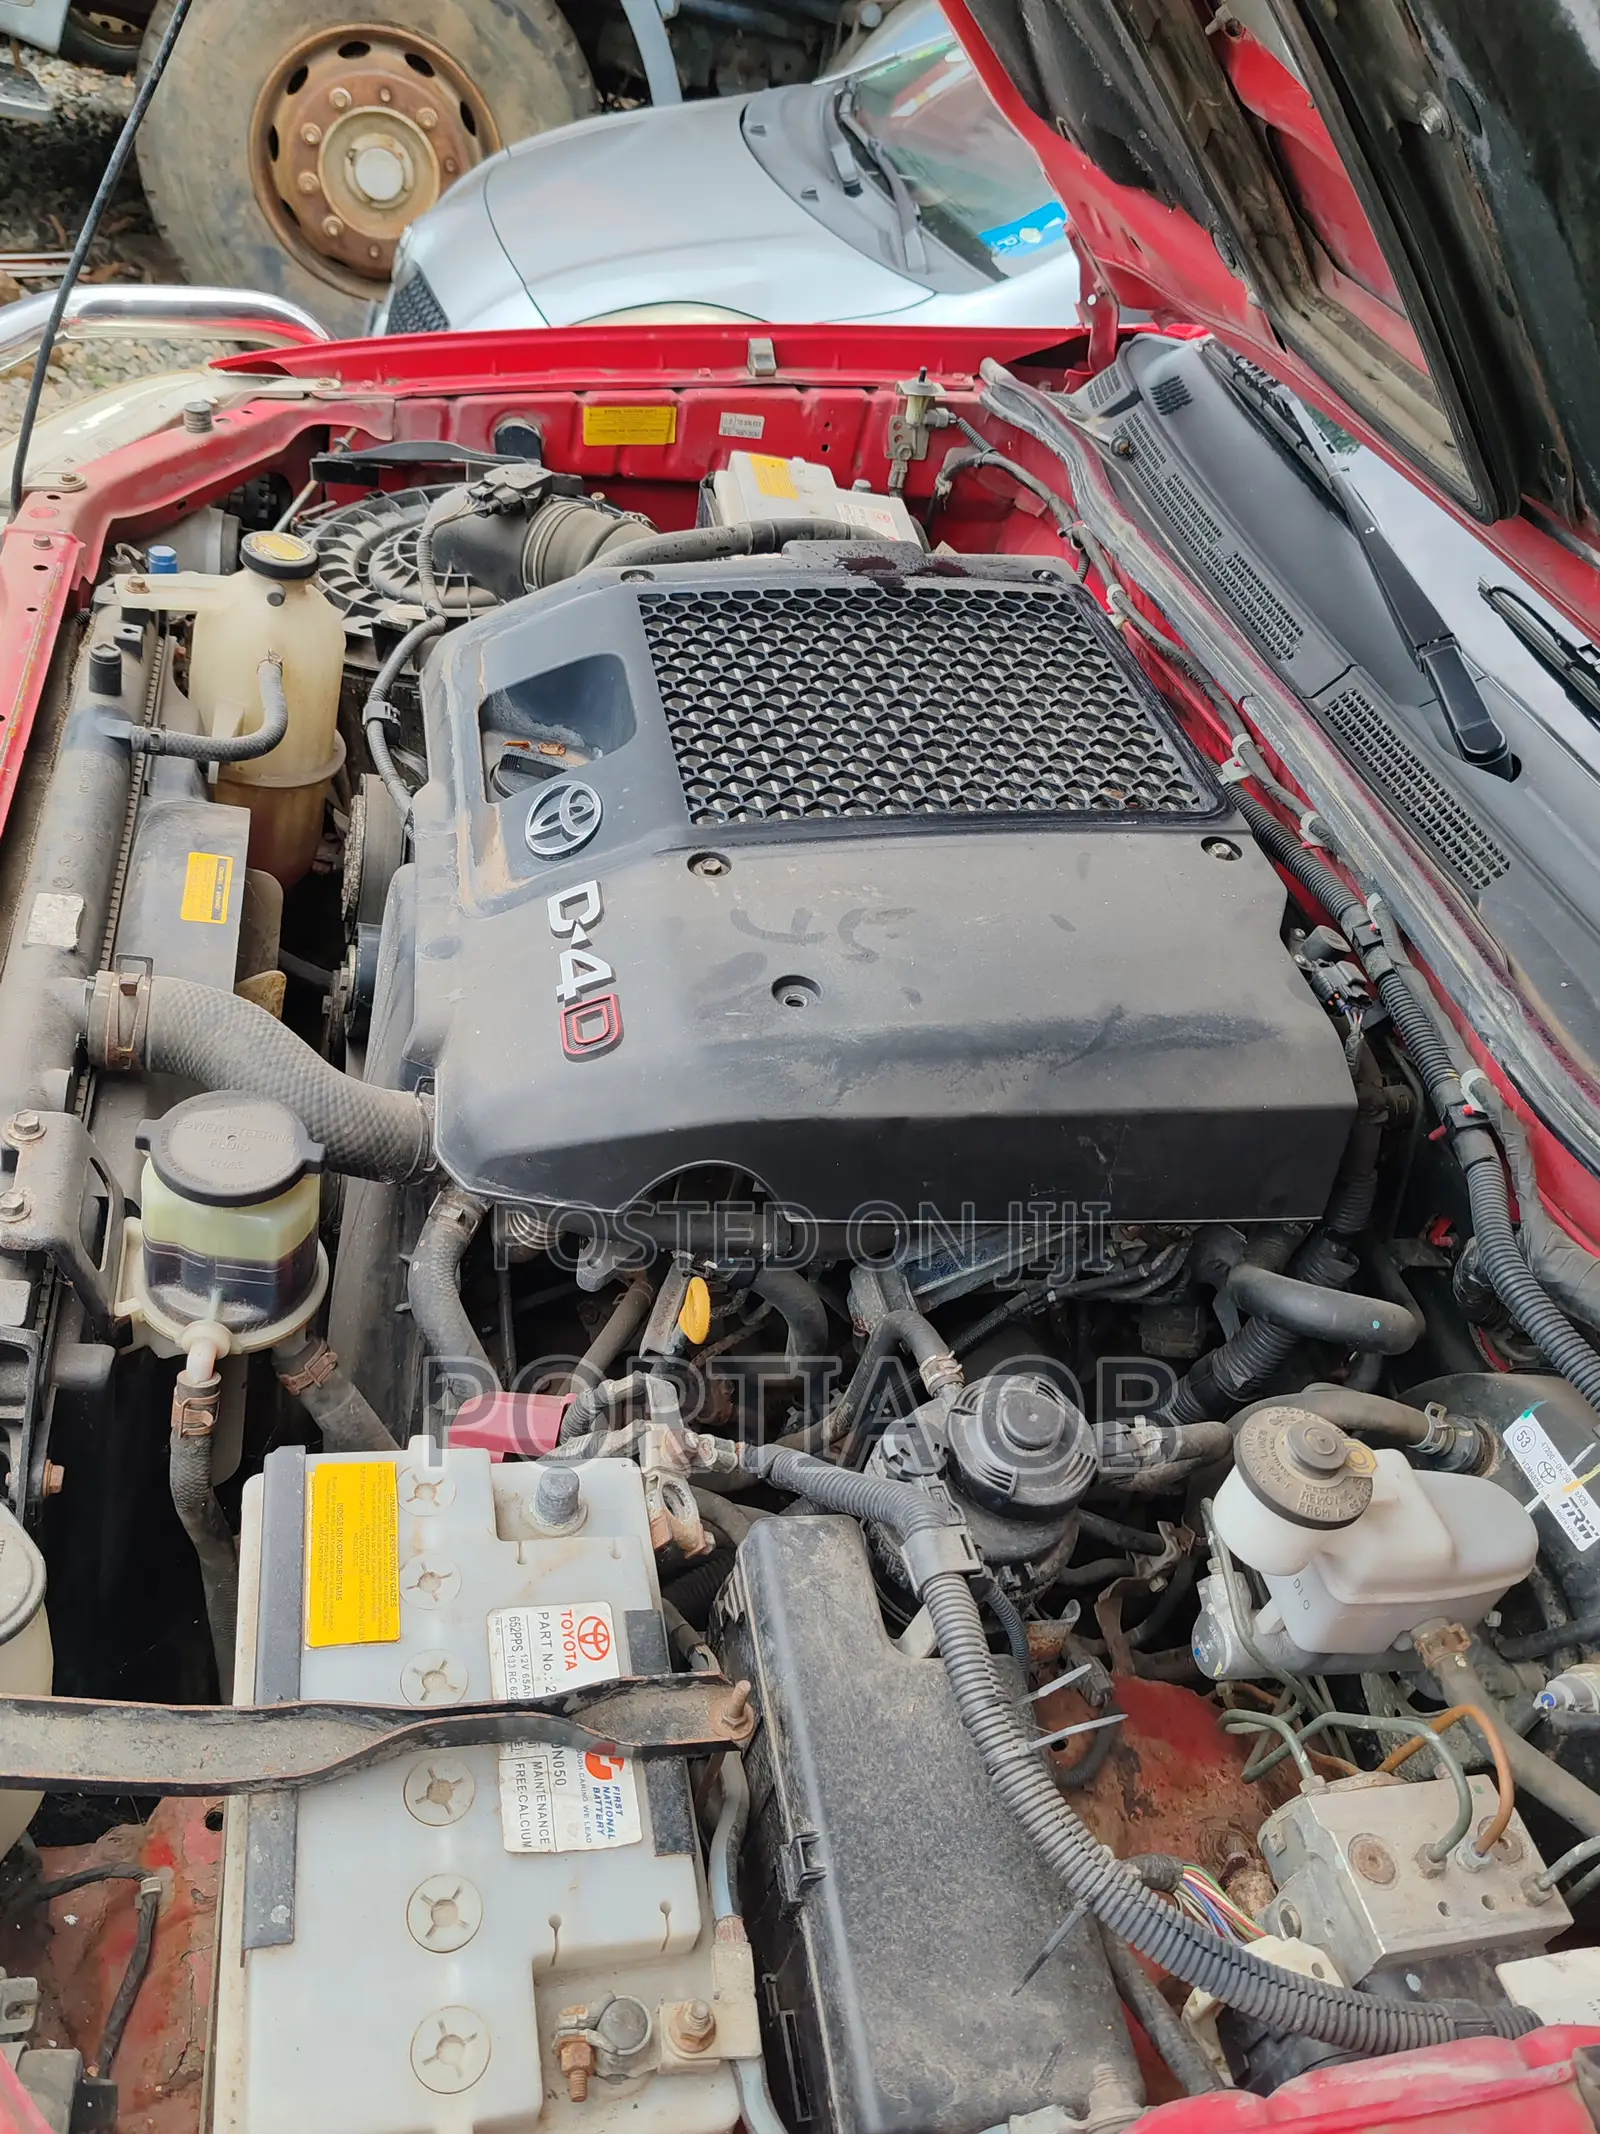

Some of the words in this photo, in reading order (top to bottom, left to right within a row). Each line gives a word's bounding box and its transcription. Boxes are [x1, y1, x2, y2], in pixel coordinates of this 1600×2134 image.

[173, 1119, 224, 1133] POWER
[228, 1126, 295, 1144] STEERING
[208, 1139, 250, 1152] FLUID
[209, 1160, 245, 1170] CLOSE
[1516, 1430, 1532, 1448] 53
[1297, 1502, 1331, 1518] FROM
[1560, 1496, 1600, 1540] TRW
[336, 1528, 343, 1538] UN
[508, 1616, 523, 1652] 652PPS
[538, 1612, 552, 1648] PART
[560, 1609, 578, 1671] TOYOTA
[507, 1654, 516, 1669] 133
[520, 1653, 528, 1670] 12V
[542, 1653, 554, 1681] No.:
[508, 1672, 517, 1685] RC
[521, 1673, 531, 1698] 65Ah
[578, 1773, 588, 1802] CARING
[532, 1761, 550, 1845] MAINTENANCE
[583, 1806, 589, 1819] WE
[593, 1786, 605, 1836] BATTERY
[602, 1786, 615, 1840] NATIONAL
[612, 1785, 624, 1816] FIRST
[584, 1821, 592, 1844] LEAD
